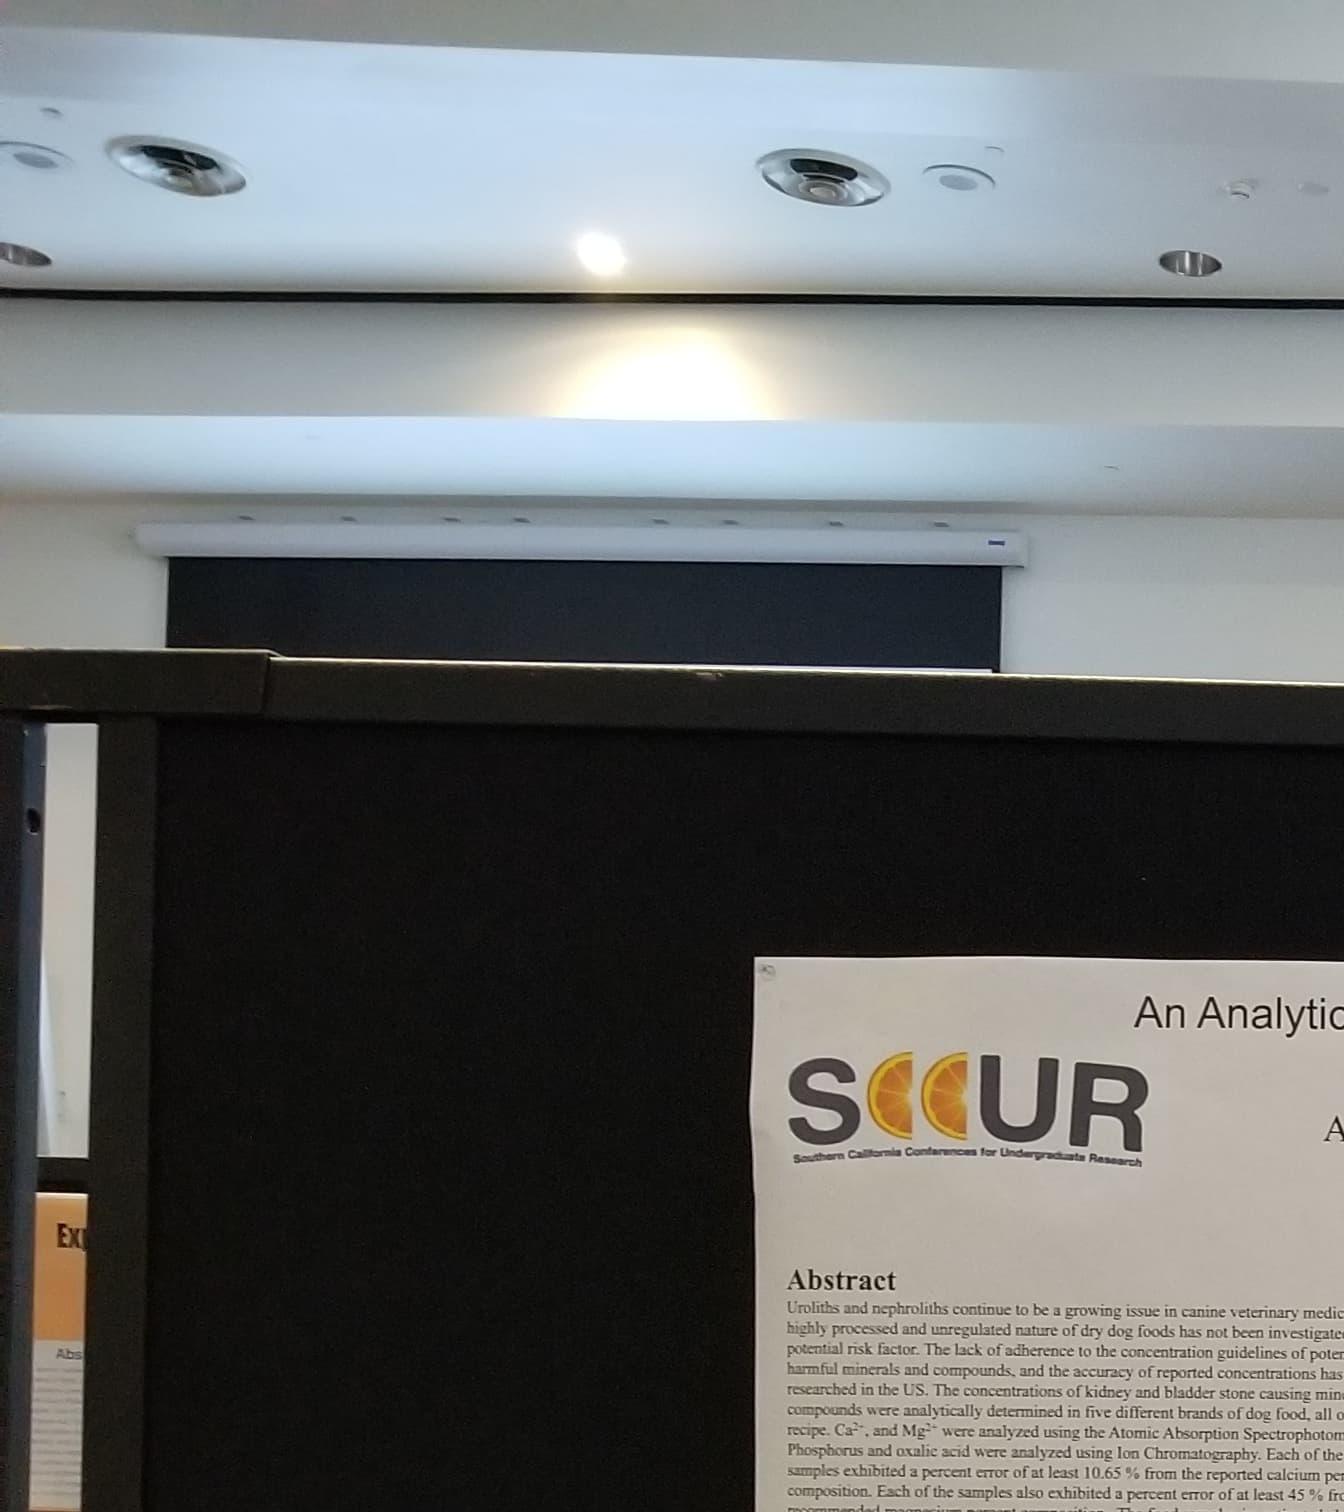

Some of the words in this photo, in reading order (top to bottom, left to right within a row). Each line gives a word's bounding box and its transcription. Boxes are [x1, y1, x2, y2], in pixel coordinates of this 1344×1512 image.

[1133, 995, 1185, 1029] An
[792, 1151, 845, 1165] Southern
[848, 1148, 902, 1160] California
[904, 1146, 977, 1158] Conferences
[980, 1147, 998, 1157] for
[1000, 1147, 1086, 1162] Undergraduate
[1088, 1153, 1143, 1168] Research
[787, 1268, 897, 1291] Abstract
[787, 1300, 841, 1315] Uroliths
[843, 1300, 869, 1315] and
[871, 1301, 949, 1319] nephroliths
[952, 1302, 1012, 1316] continue
[1015, 1304, 1030, 1317] to
[1032, 1302, 1050, 1317] be
[1052, 1306, 1062, 1317] a
[1064, 1303, 1122, 1321] growing
[1125, 1303, 1161, 1318] issue
[1164, 1304, 1178, 1318] in
[1181, 1304, 1227, 1319] canine
[1229, 1305, 1300, 1323] veterinary
